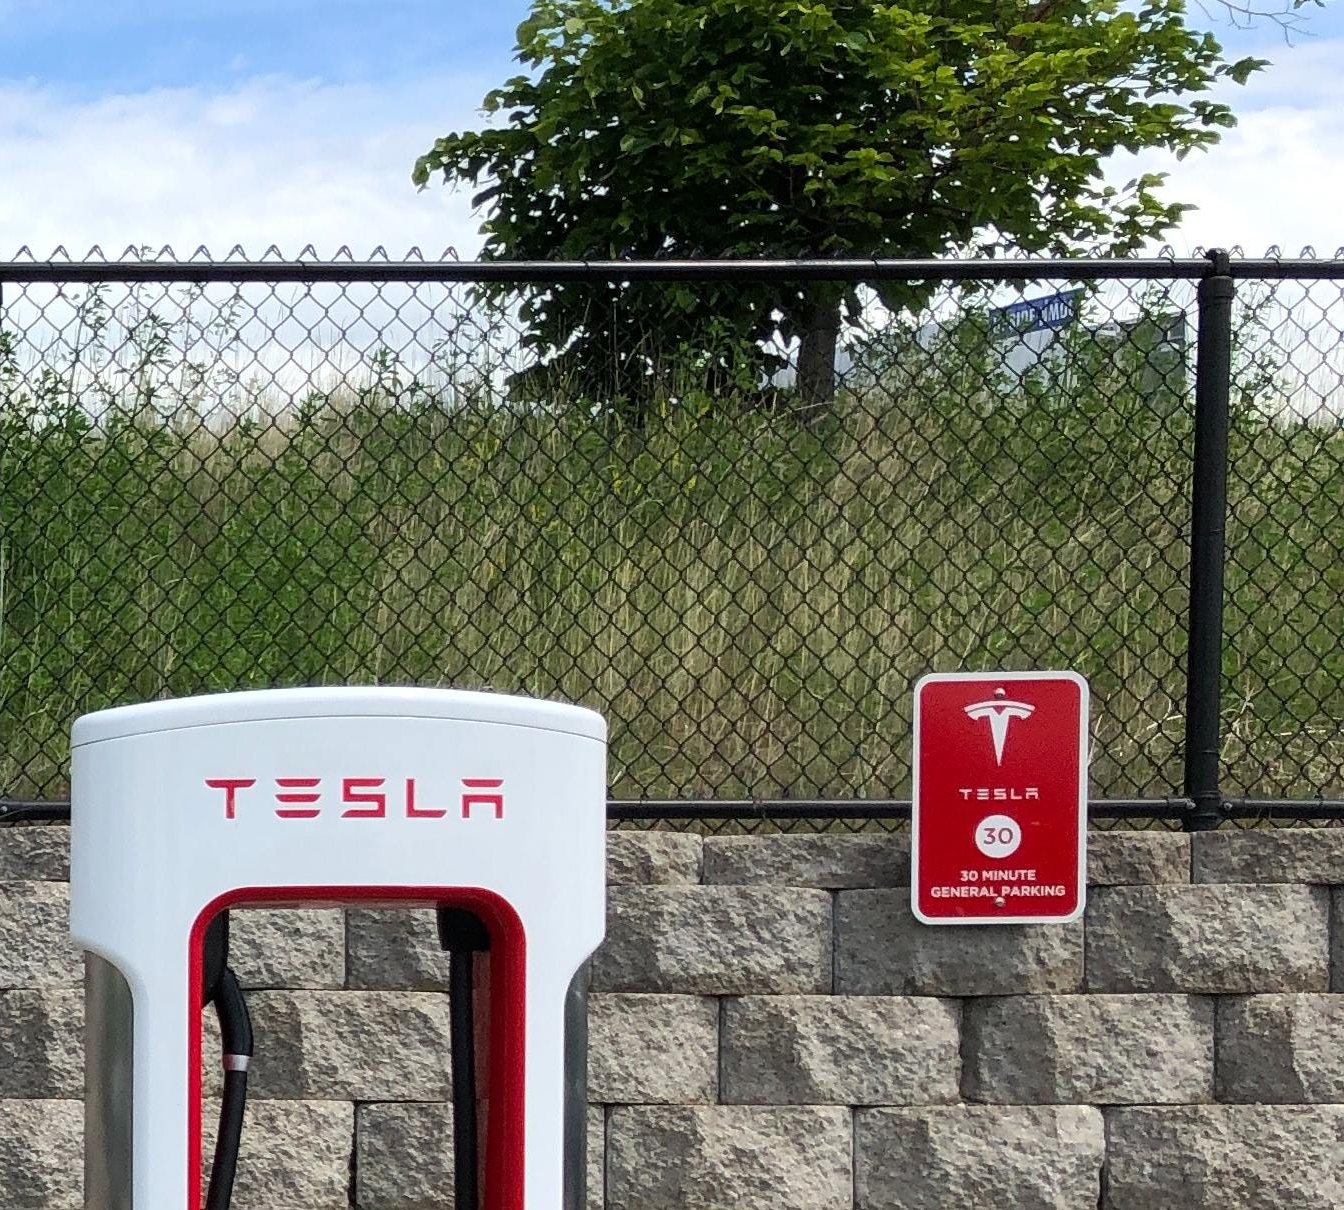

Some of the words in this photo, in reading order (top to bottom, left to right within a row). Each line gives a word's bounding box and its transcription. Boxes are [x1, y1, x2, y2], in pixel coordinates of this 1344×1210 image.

[205, 778, 504, 819] TESLA
[958, 787, 1040, 800] TESLA
[983, 827, 1014, 845] 30
[960, 870, 979, 882] 30
[982, 869, 1036, 881] MINUTE
[931, 886, 998, 898] GENERAL
[1001, 885, 1066, 897] PARKING
